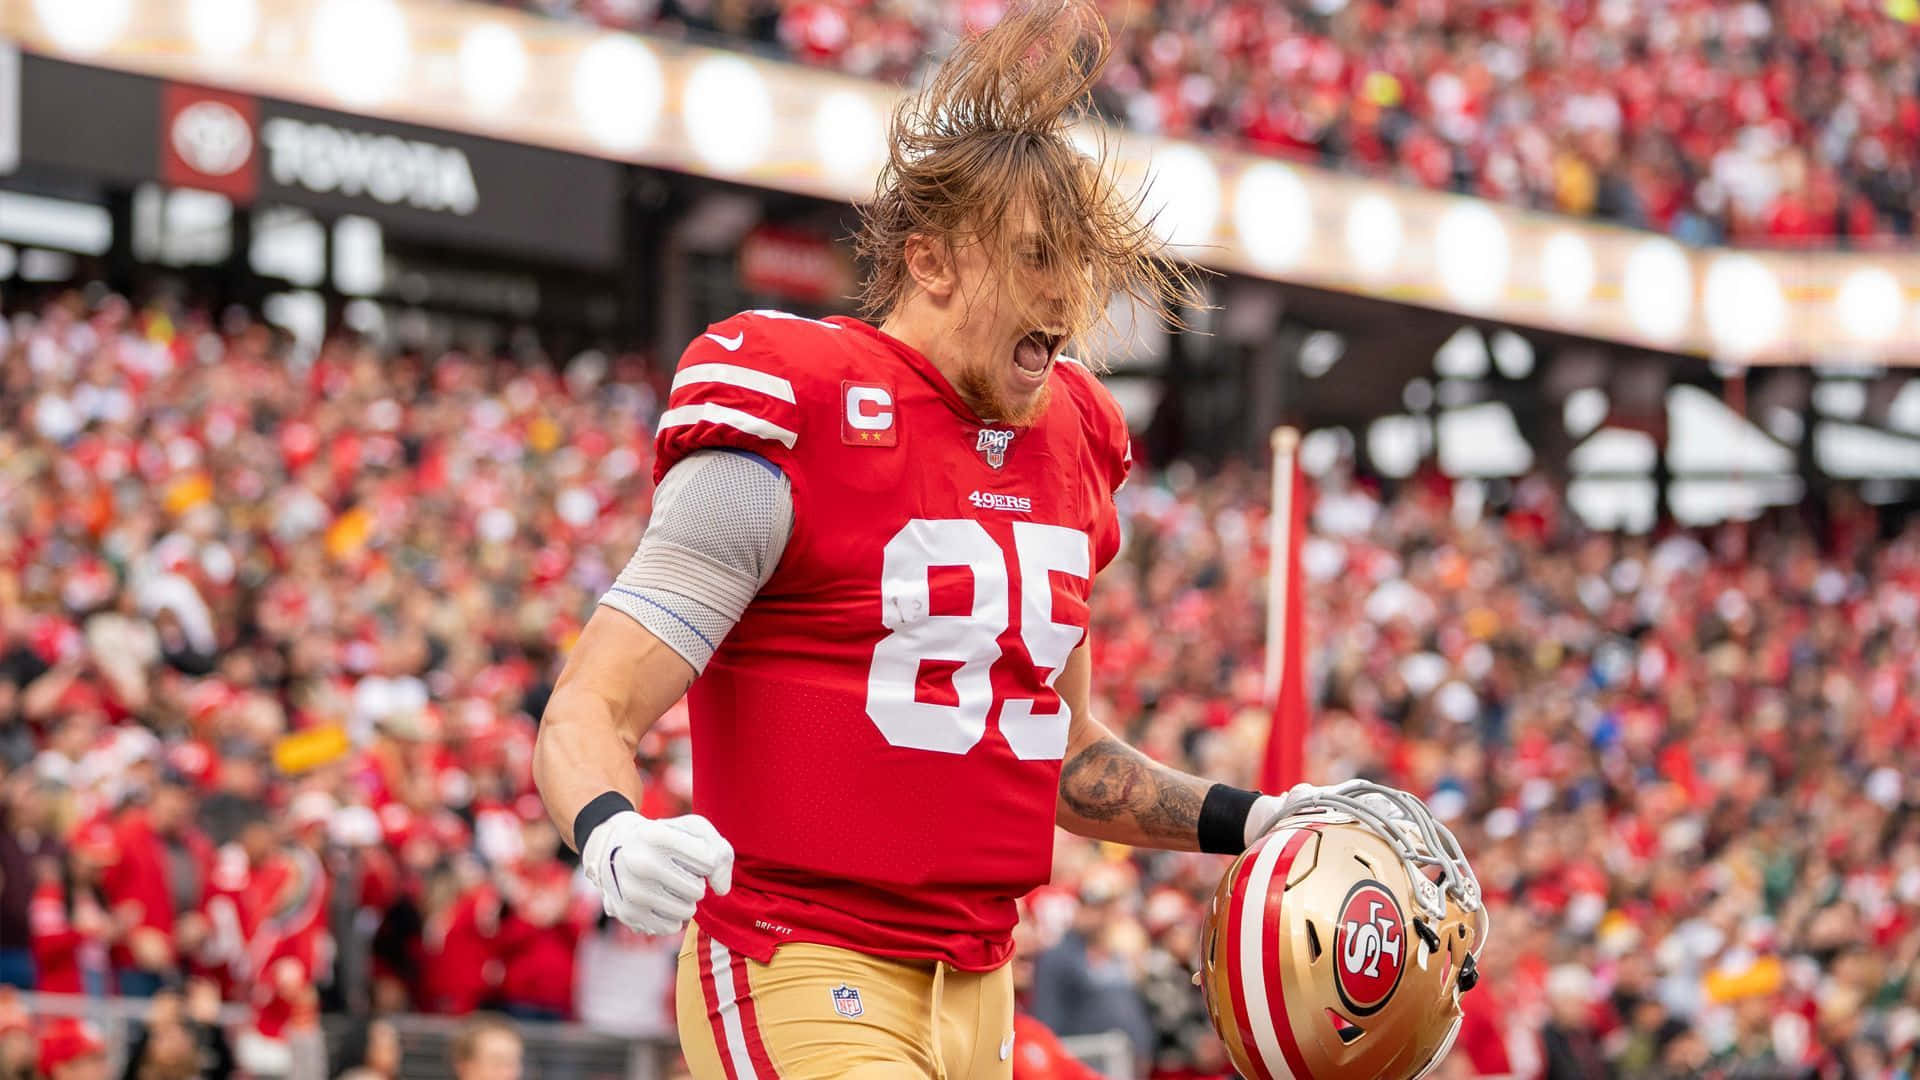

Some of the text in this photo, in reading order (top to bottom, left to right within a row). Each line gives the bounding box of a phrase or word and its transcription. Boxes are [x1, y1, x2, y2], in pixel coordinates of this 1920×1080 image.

[264, 118, 479, 215] TOYOTA
[847, 386, 892, 430] C
[968, 491, 1032, 511] 49ERS
[865, 518, 1090, 761] 85
[838, 999, 860, 1013] NFL
